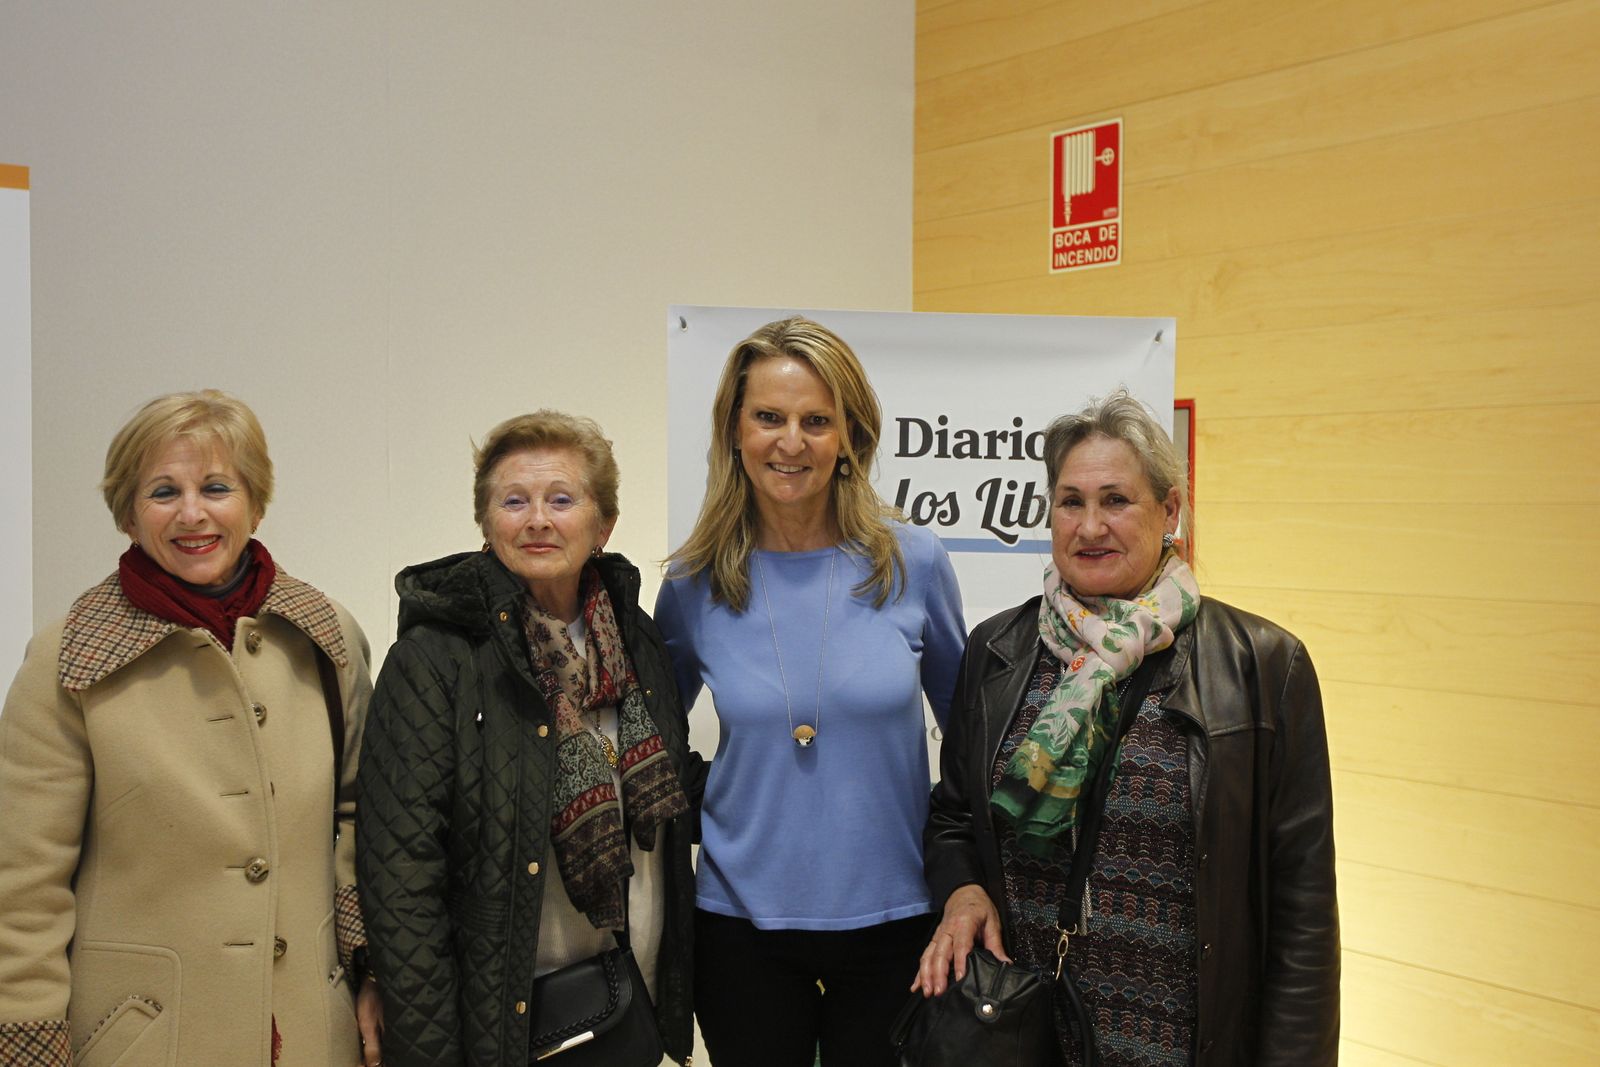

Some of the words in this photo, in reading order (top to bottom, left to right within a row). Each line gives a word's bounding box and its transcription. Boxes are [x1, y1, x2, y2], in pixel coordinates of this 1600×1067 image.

[1055, 230, 1091, 248] BOCA
[1099, 225, 1116, 242] DE
[1055, 245, 1117, 267] INCENDIO
[894, 414, 1046, 461] Diario
[894, 478, 960, 526] los
[975, 477, 1052, 545] Lib
